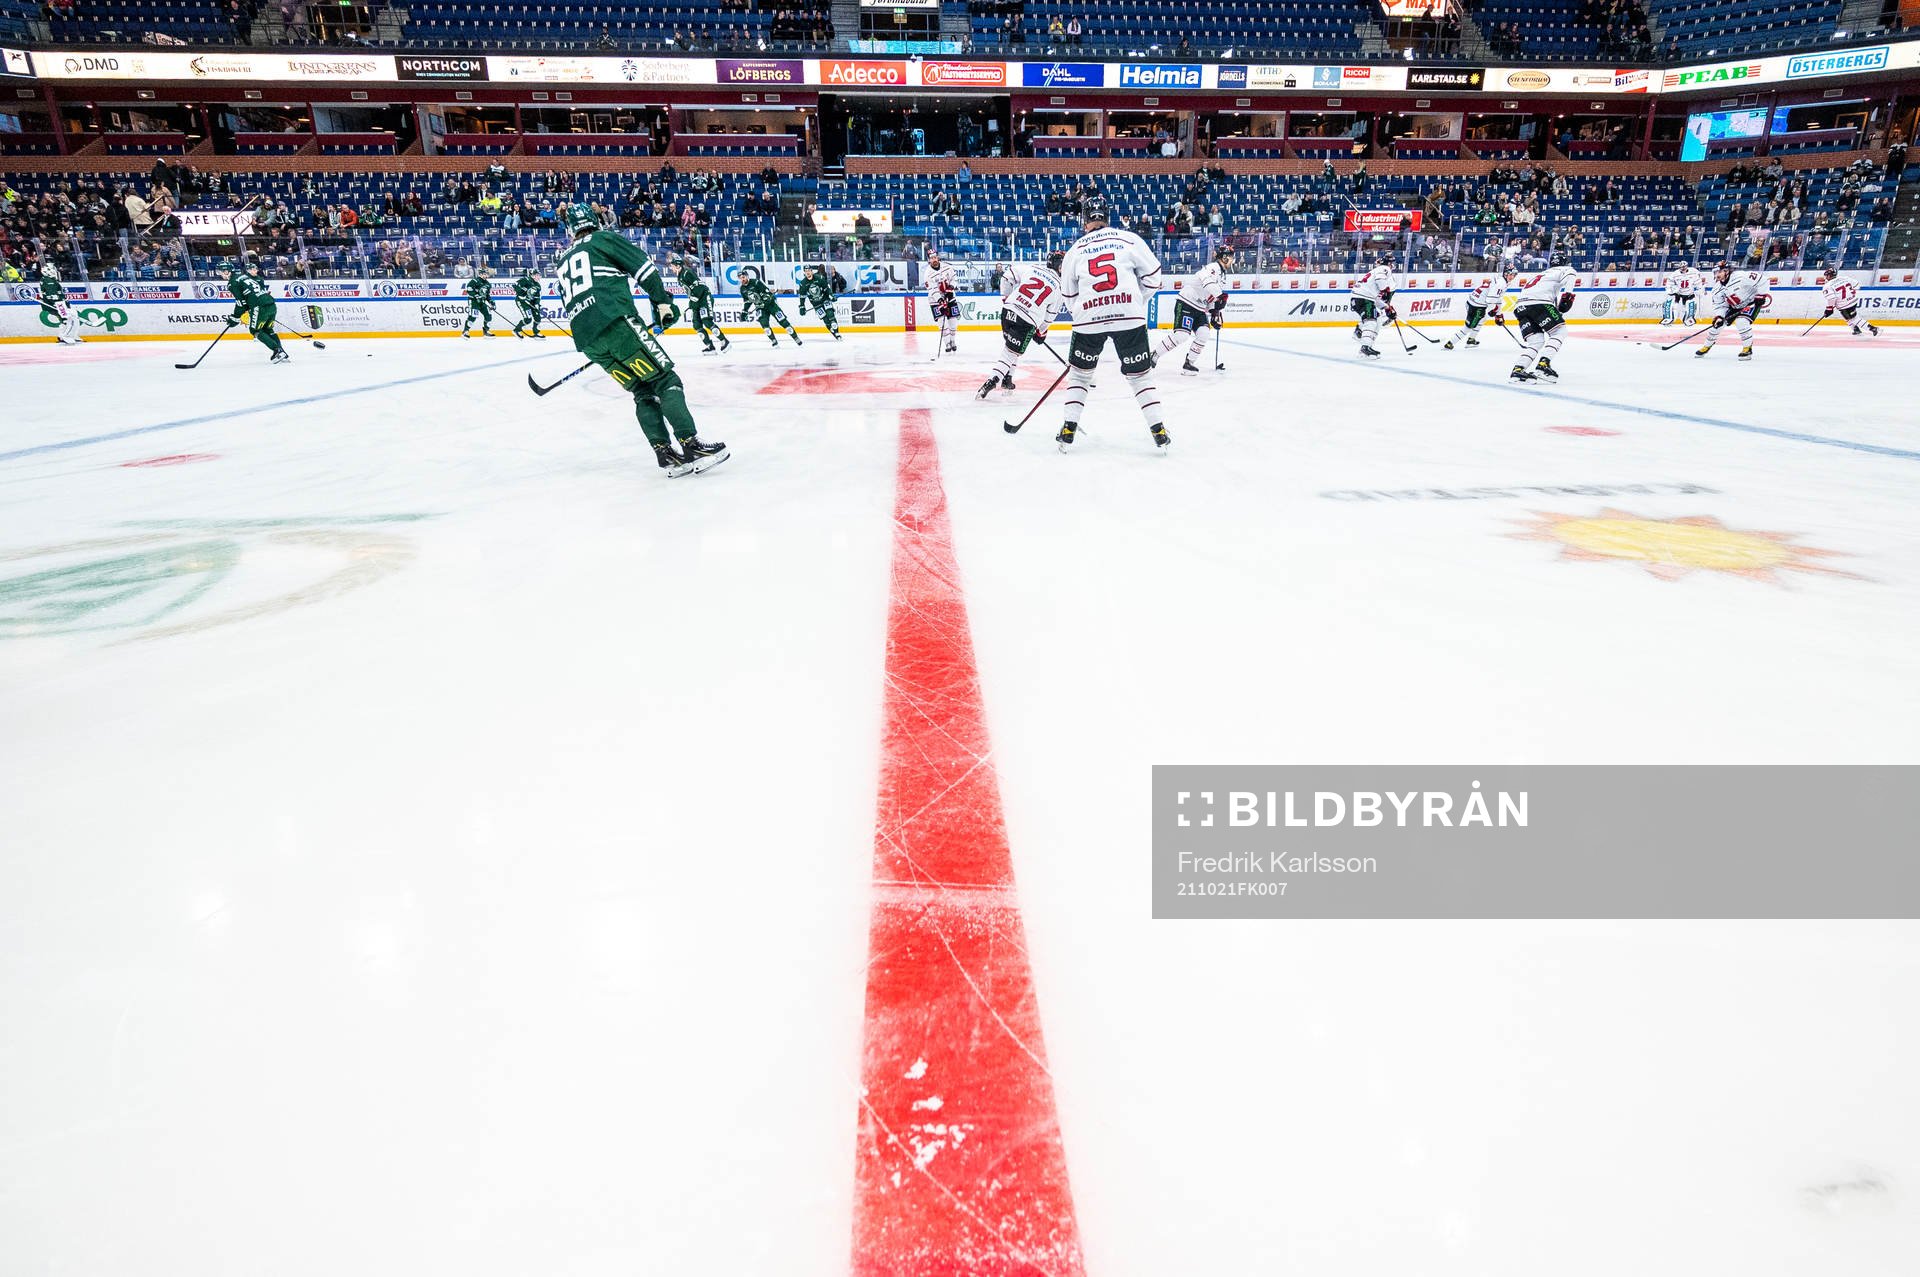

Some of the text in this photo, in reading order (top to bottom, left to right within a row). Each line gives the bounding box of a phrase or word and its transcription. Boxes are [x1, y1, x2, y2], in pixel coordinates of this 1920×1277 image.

[84, 58, 119, 71] DMD
[402, 60, 480, 71] NORTHCOM
[1042, 68, 1072, 76] DAHL
[1792, 52, 1884, 74] ÖSTERBERGS
[730, 68, 791, 80] LÖFBERGS
[828, 64, 898, 83] Adecco
[1122, 66, 1200, 84] Helmia
[1411, 74, 1468, 84] KARLSTAD.SE
[1678, 66, 1750, 85] PEAB
[1088, 253, 1118, 292] 5
[1018, 276, 1052, 307] 21
[168, 314, 228, 324] KARLSTAD.S
[623, 314, 672, 369] LARAVIK
